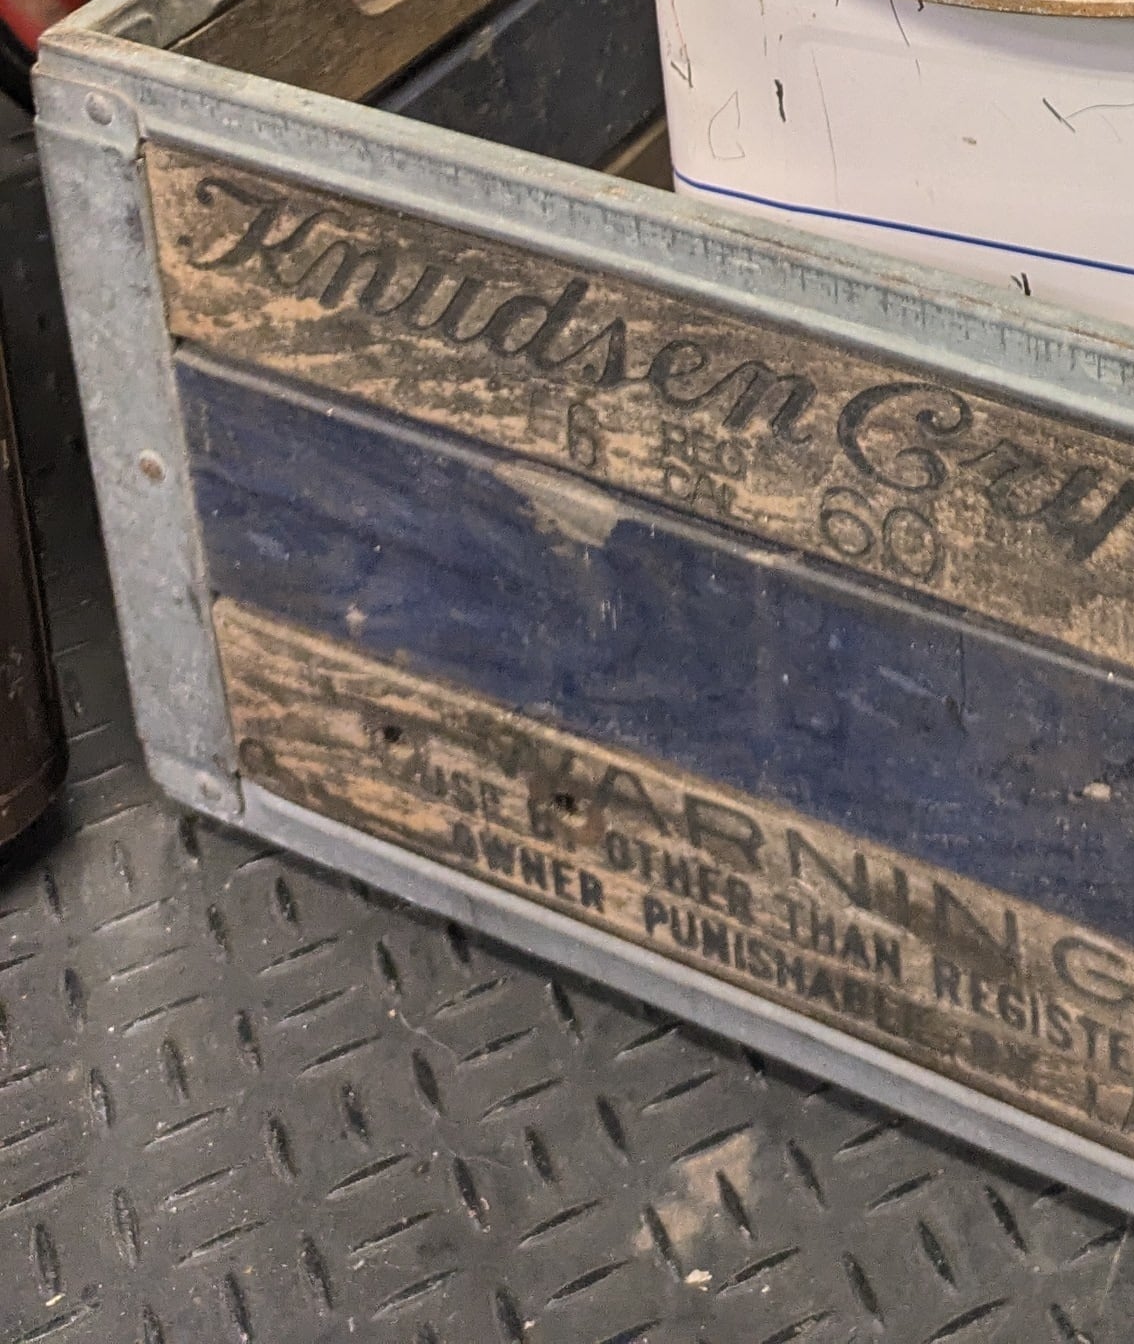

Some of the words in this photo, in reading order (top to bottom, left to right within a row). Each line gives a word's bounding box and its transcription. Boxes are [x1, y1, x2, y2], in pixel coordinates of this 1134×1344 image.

[187, 176, 818, 443] Knudsen
[452, 820, 605, 914] OWNER
[604, 829, 753, 925] OTHER
[772, 892, 900, 979] THAN
